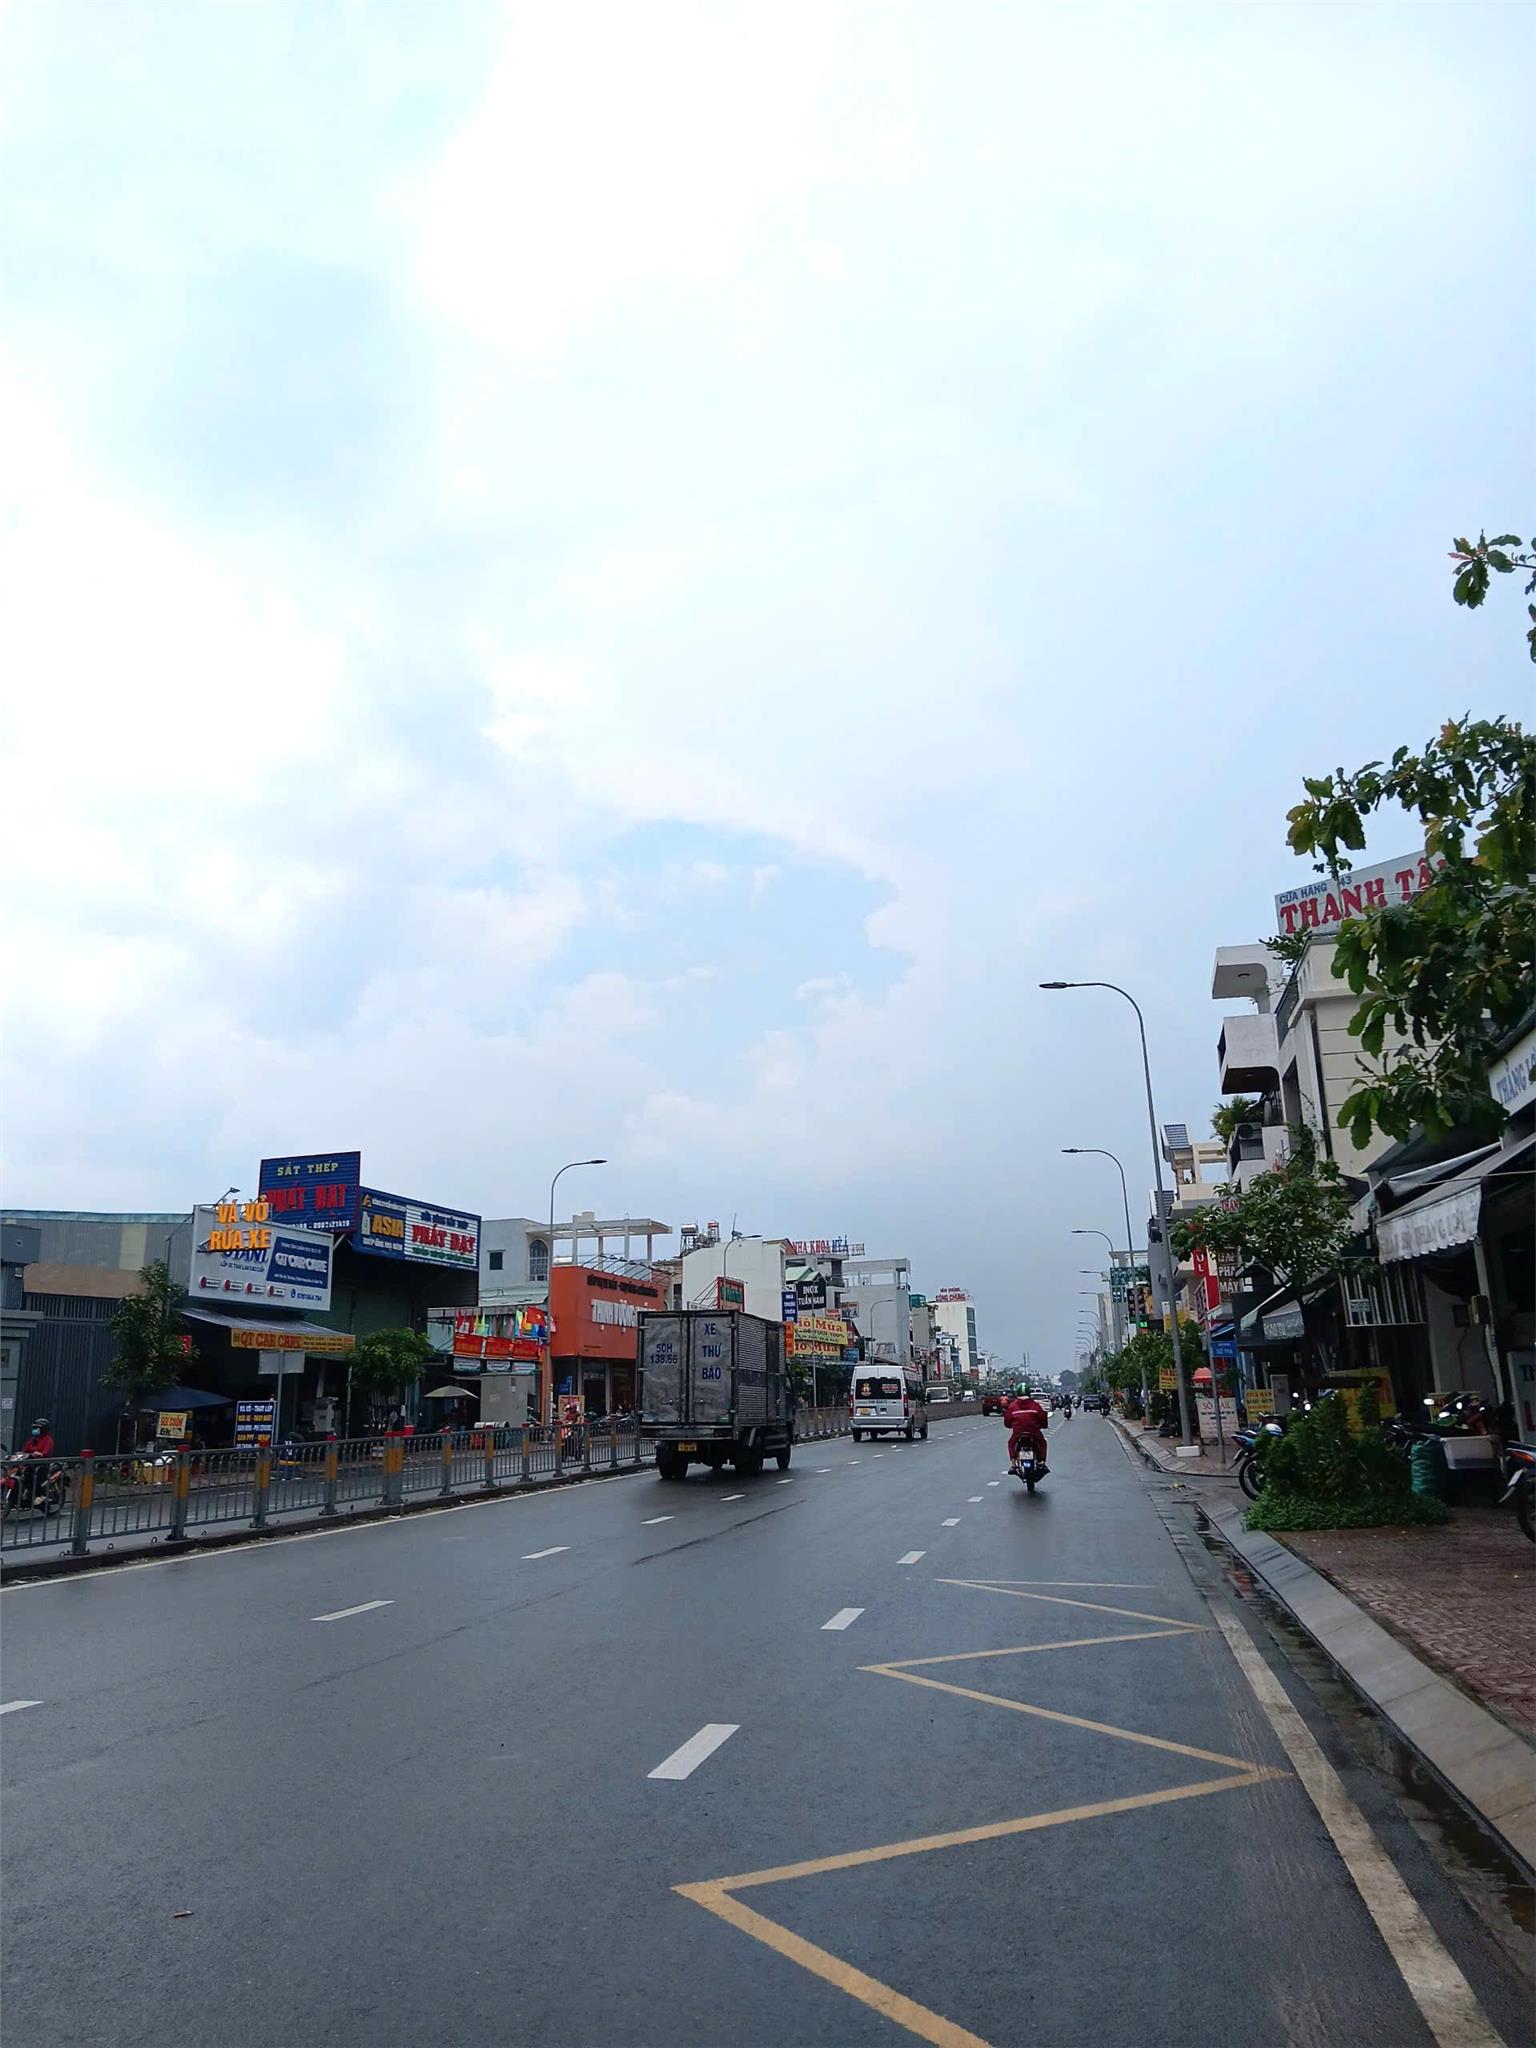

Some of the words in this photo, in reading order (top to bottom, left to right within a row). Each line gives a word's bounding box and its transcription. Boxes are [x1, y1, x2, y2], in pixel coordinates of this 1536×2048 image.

[1280, 877, 1388, 934] THANH
[1394, 856, 1448, 901] TÂ
[307, 1159, 338, 1174] THÉP
[372, 1214, 404, 1238] ASIA
[248, 1228, 272, 1249] XE
[1219, 1278, 1239, 1292] MÁY
[704, 1323, 716, 1335] XE
[656, 1344, 673, 1353] 50H
